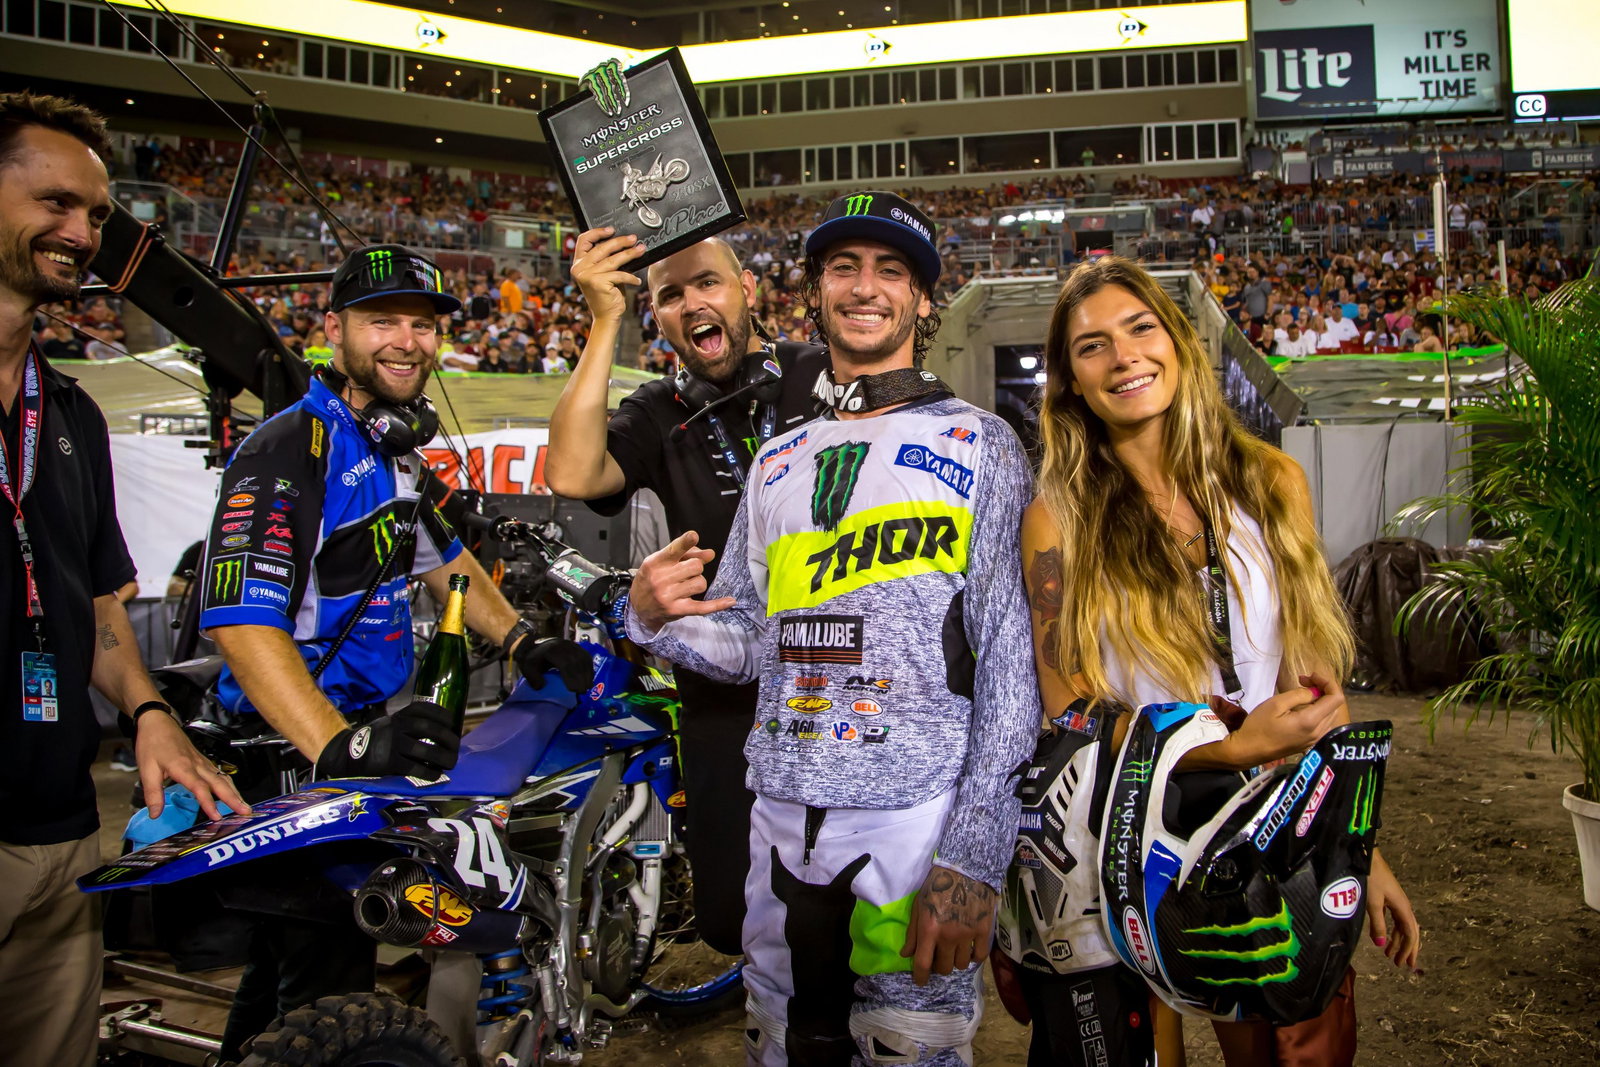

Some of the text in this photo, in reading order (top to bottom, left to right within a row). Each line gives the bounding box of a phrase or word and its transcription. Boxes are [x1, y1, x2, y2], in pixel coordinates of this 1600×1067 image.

[1425, 30, 1468, 49] IT'S
[1258, 47, 1352, 102] Lite
[1404, 53, 1491, 75] MILLER
[1419, 78, 1477, 99] TIME
[1519, 100, 1542, 113] CC
[582, 103, 664, 148] MONSTER
[576, 117, 684, 174] SUPERCROSS
[1346, 163, 1365, 171] FAN
[1545, 153, 1593, 164] FAN DECK
[669, 200, 726, 232] Place
[903, 212, 931, 241] YAMAHA
[814, 368, 863, 412] 100%
[763, 424, 772, 438] FS1
[805, 516, 960, 595] THOR
[254, 561, 289, 578] YAMALUBE
[260, 587, 287, 602] YAMAHA
[781, 622, 856, 648] YAMALUBE
[854, 702, 880, 713] BELL
[1304, 766, 1334, 819] FLEX
[1045, 812, 1062, 831] THOR
[427, 816, 513, 894] 24
[1109, 806, 1121, 884] ENERGY
[1118, 789, 1140, 901] MONSTER
[1328, 887, 1357, 908] BELL
[1050, 942, 1069, 957] 100%
[1128, 916, 1150, 965] BELL
